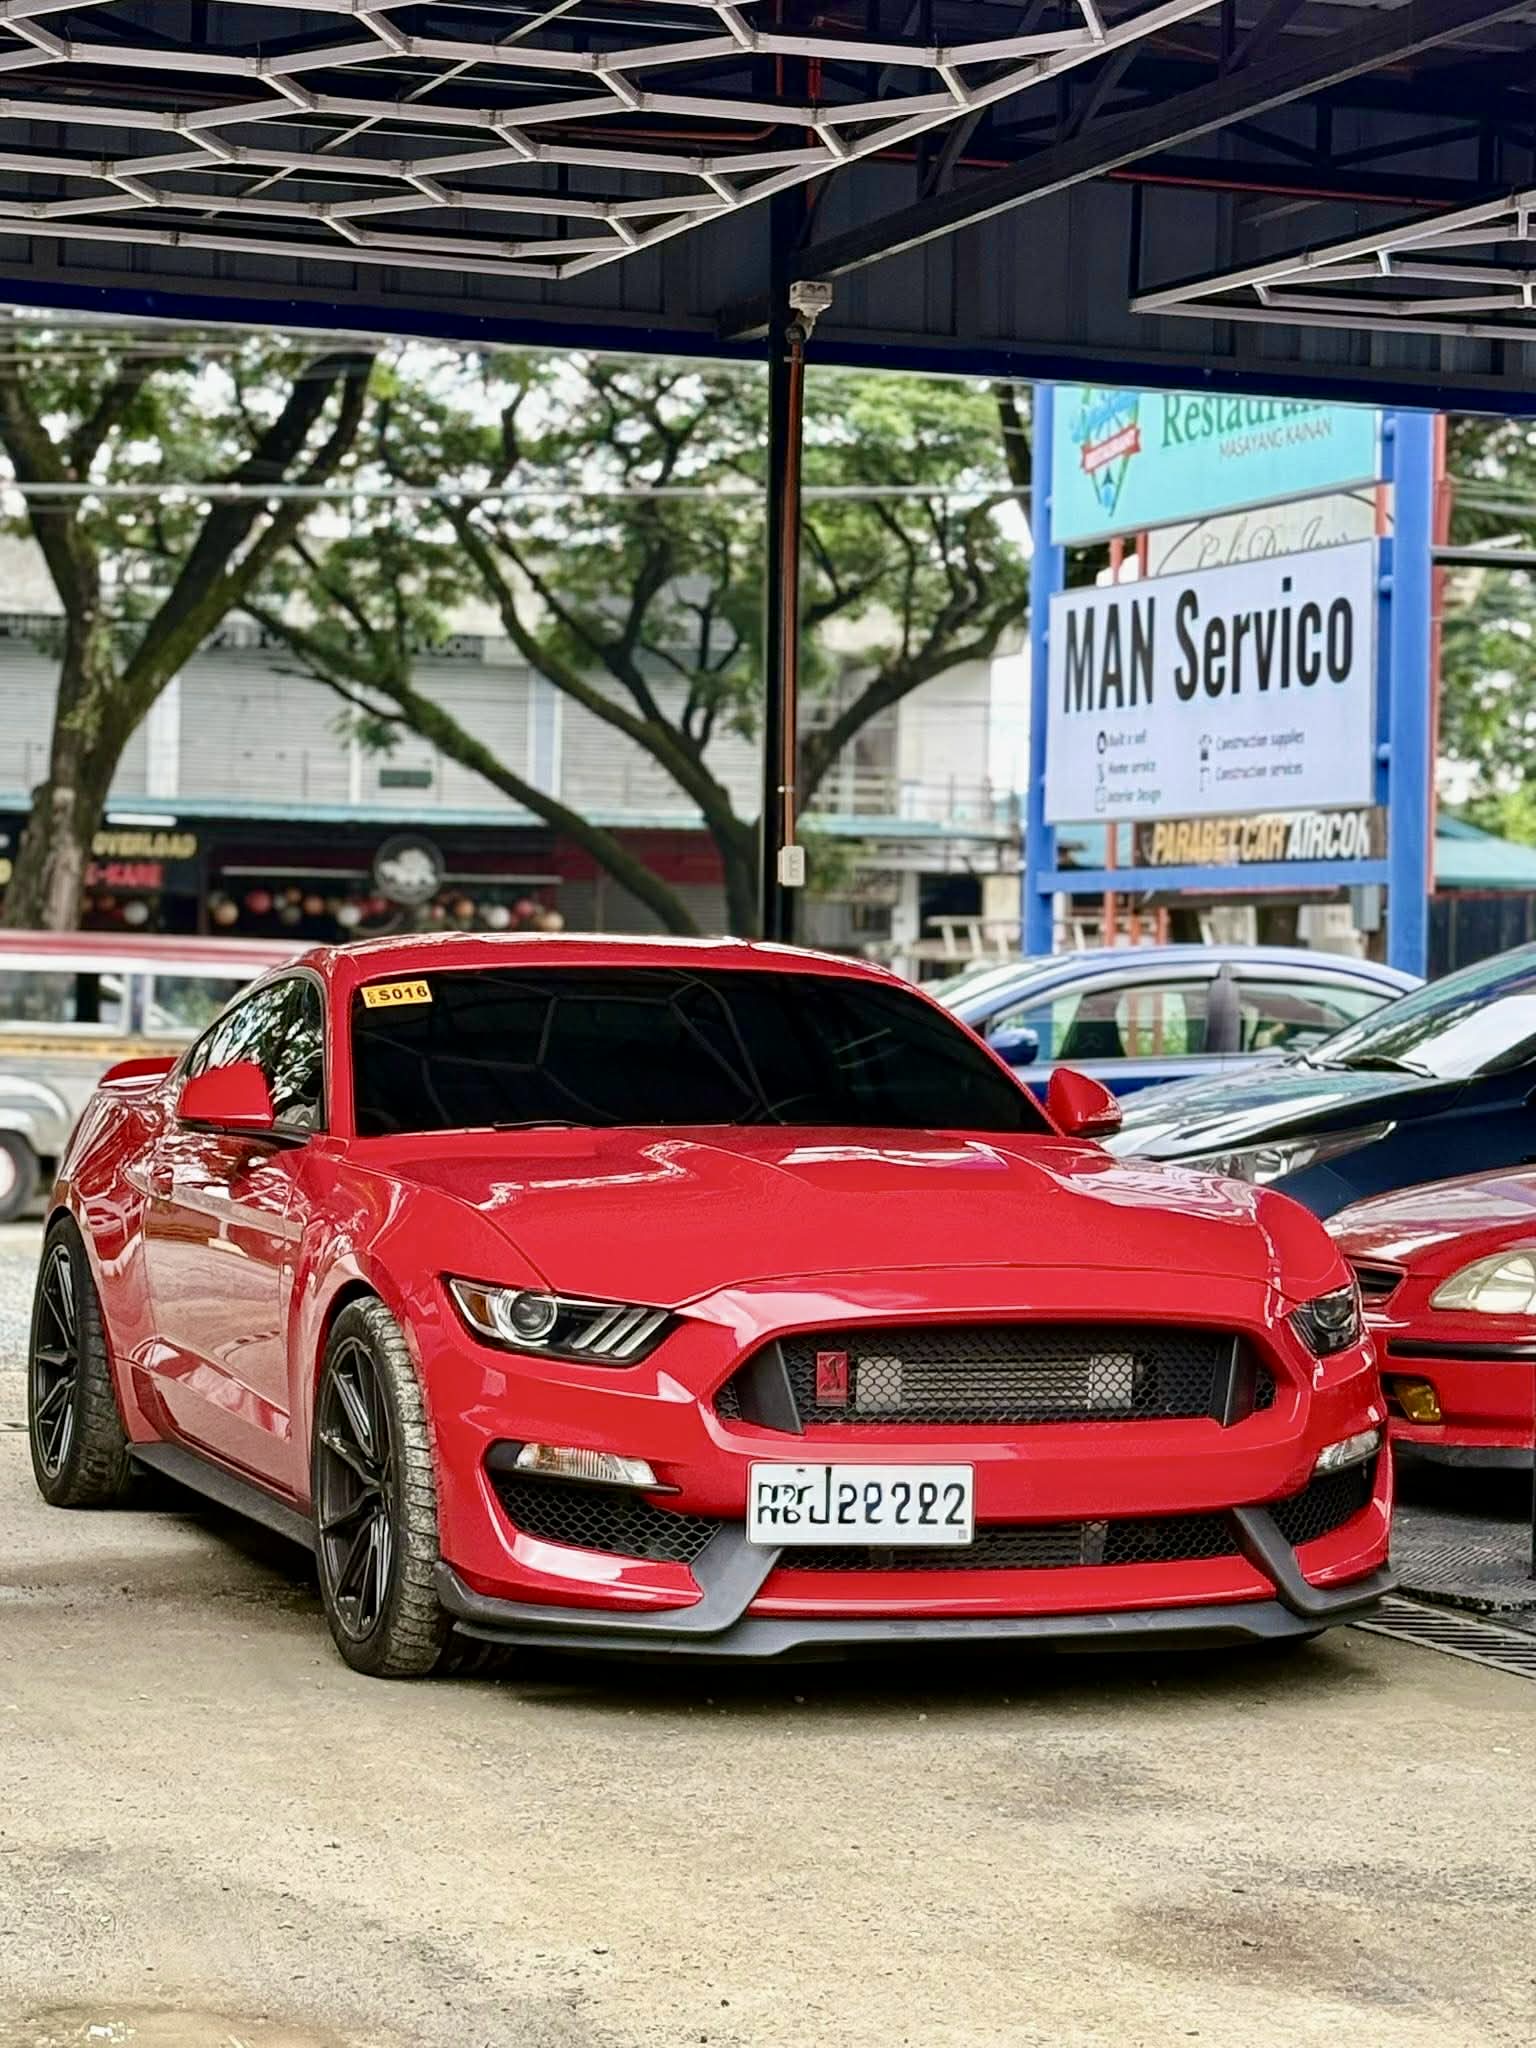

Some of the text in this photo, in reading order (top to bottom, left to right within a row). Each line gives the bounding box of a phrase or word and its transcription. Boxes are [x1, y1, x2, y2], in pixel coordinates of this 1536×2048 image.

[1161, 394, 1323, 448] Restaur
[1064, 577, 1353, 713] MAN Servico
